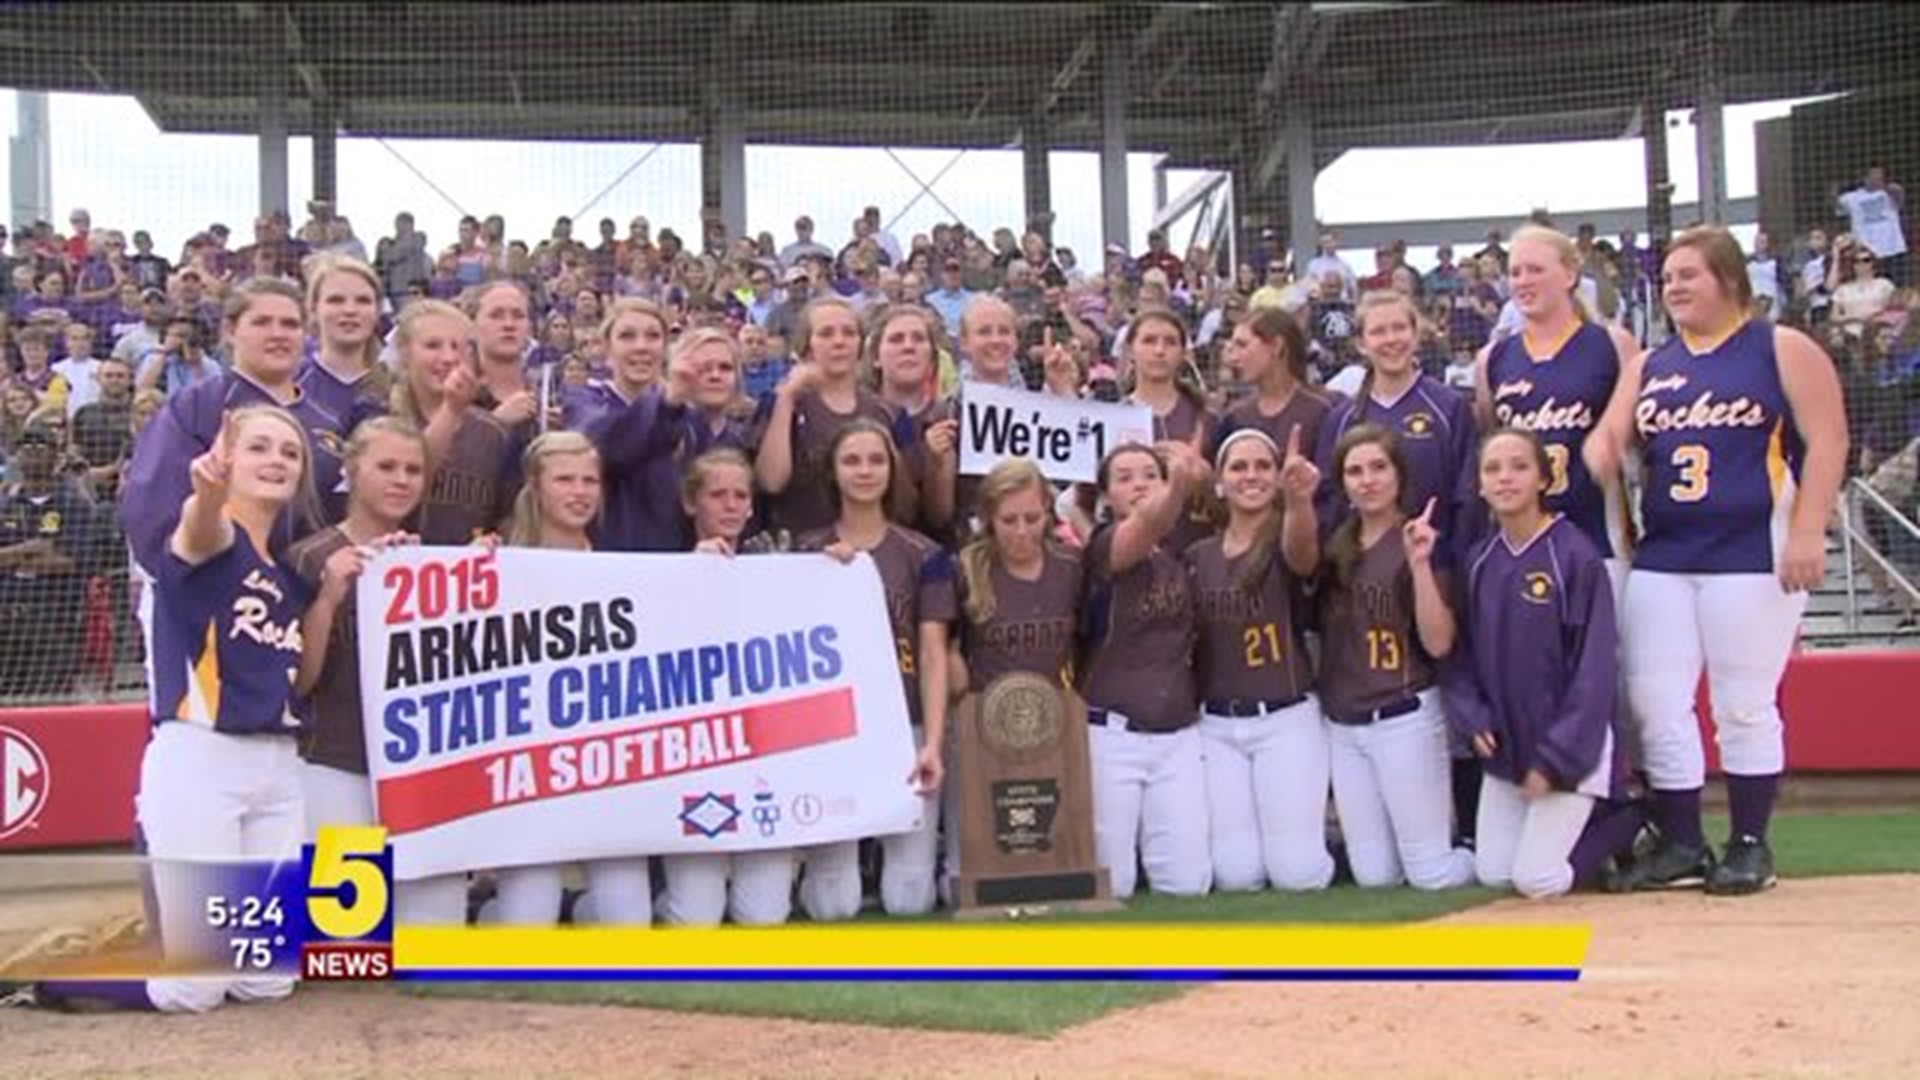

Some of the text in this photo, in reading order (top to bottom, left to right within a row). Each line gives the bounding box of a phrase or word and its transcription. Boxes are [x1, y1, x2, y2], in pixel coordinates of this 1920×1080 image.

[968, 402, 1105, 463] We're #1
[1636, 390, 1766, 440] Rockets
[1669, 445, 1710, 502] 3
[384, 555, 500, 626] 2015
[384, 597, 638, 691] ARKANSAS
[1243, 622, 1281, 667] 21
[1365, 628, 1401, 671] 13
[384, 624, 844, 764] STATE CHAMPIONS
[485, 714, 752, 802] 1A SOFTBALL
